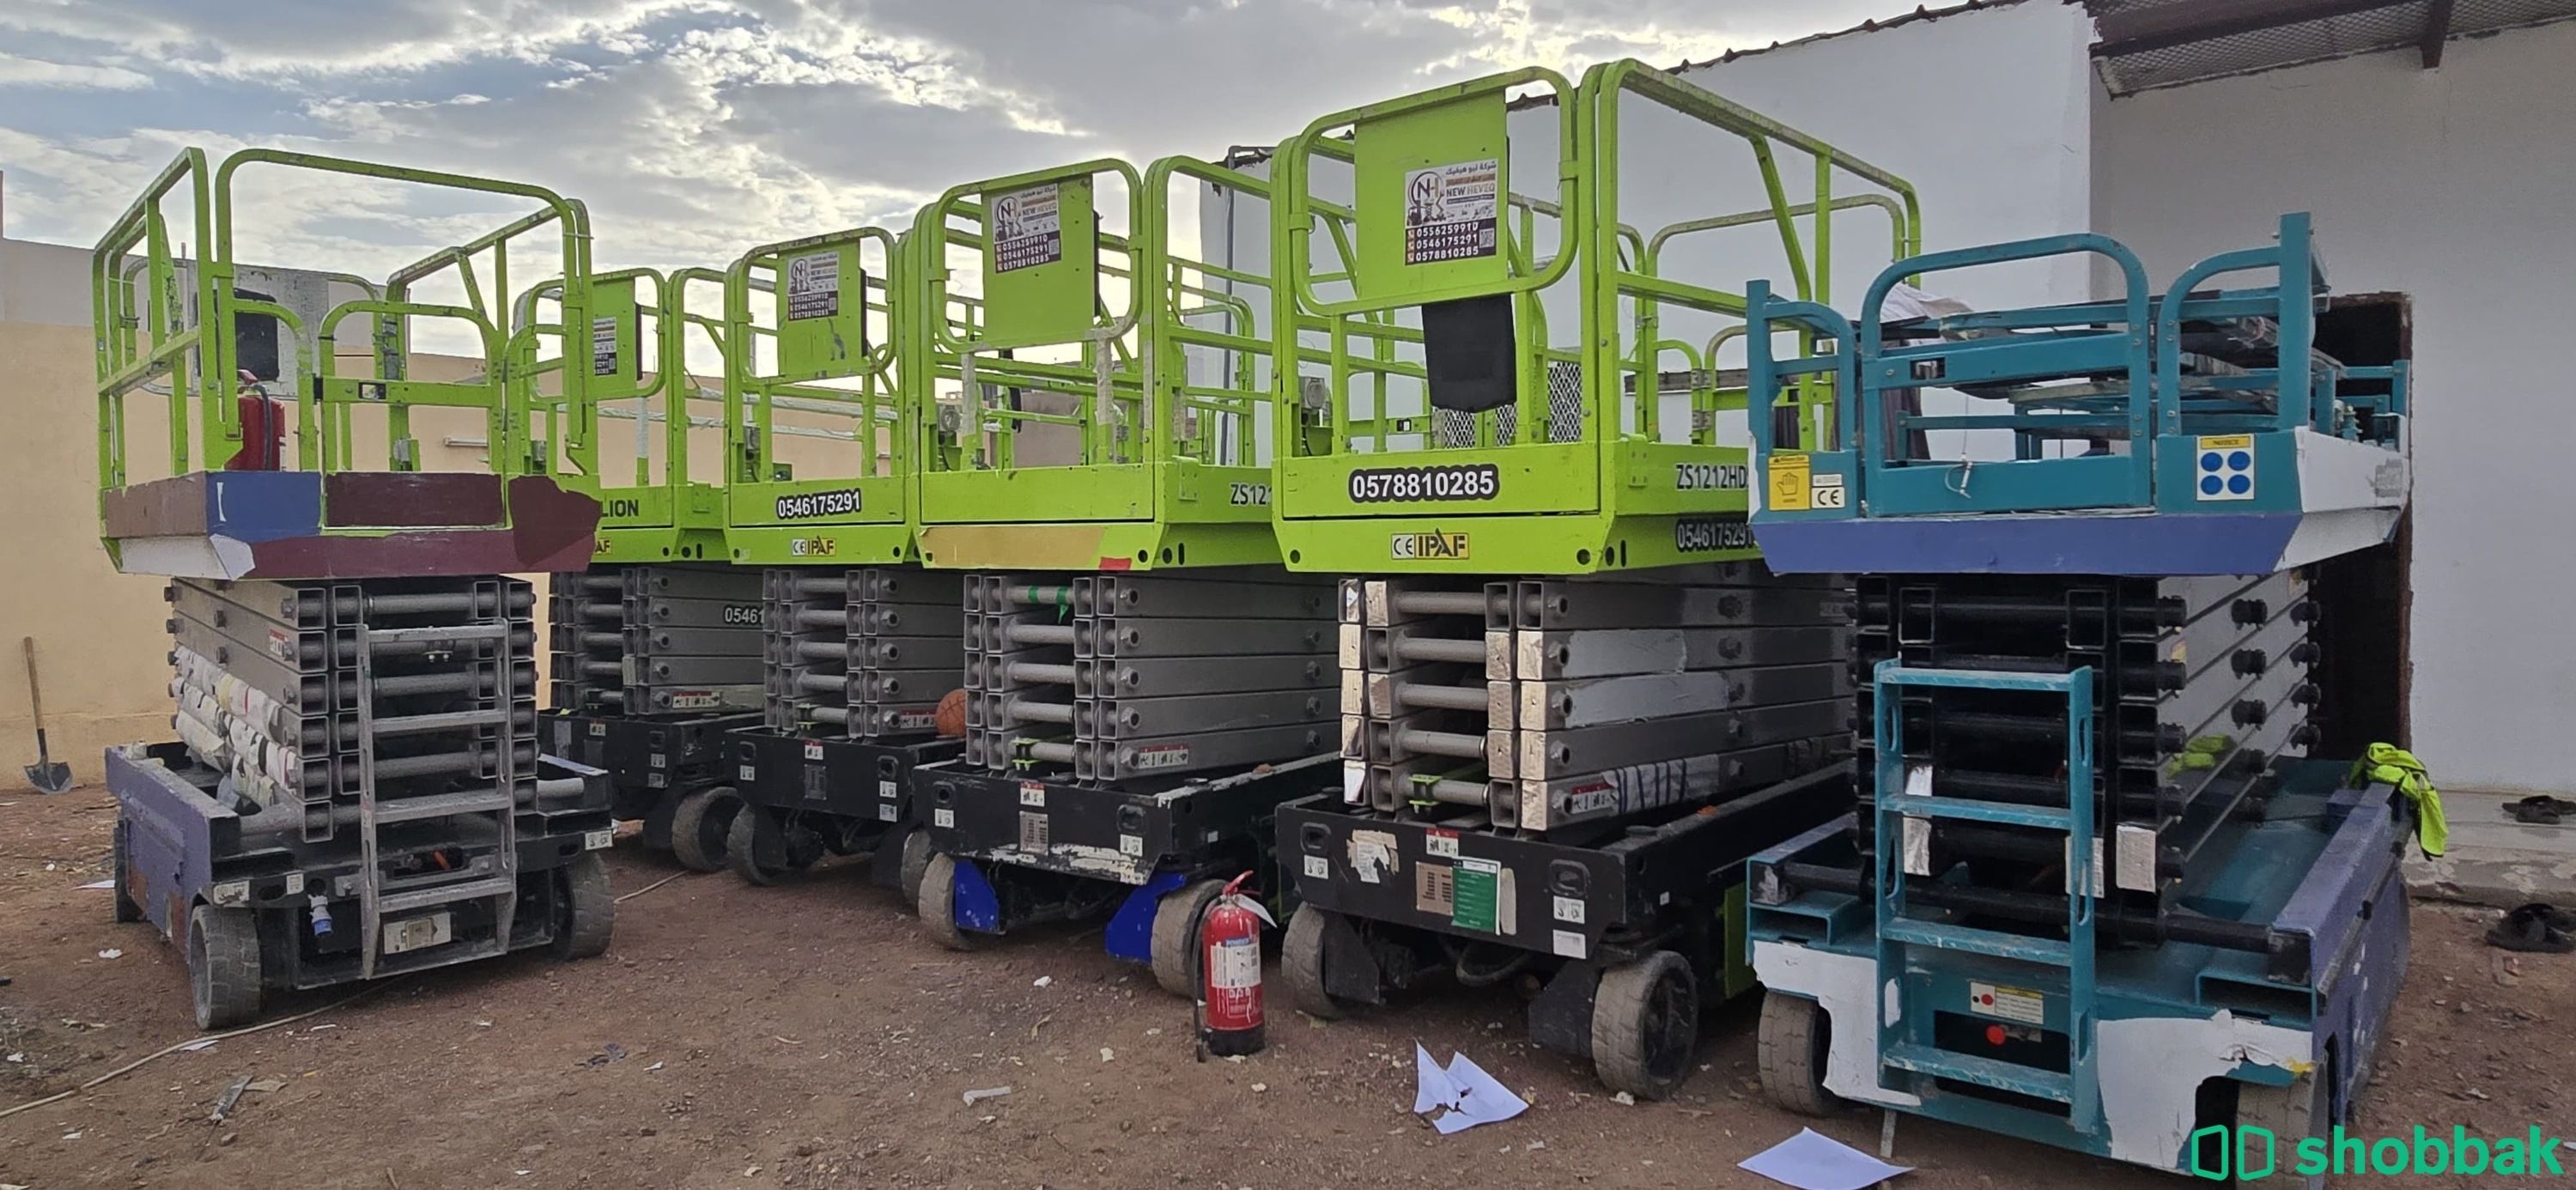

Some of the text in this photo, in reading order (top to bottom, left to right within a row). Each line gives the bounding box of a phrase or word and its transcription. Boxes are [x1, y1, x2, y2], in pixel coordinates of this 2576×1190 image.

[1446, 186, 1466, 197] NEW
[1416, 222, 1479, 237] 0556259910
[1416, 234, 1478, 249] 0546175291
[1003, 244, 1048, 260] 0546175291
[1415, 246, 1479, 261] 0578810285
[1003, 253, 1049, 270] 0578810285
[1352, 470, 1495, 498] 0578810285
[1675, 464, 1749, 490] ZS1212HD
[1230, 483, 1273, 506] ZS12
[1817, 489, 1840, 507] CE
[778, 490, 860, 518] 0546175291
[1394, 527, 1466, 557] CE IPAF
[1677, 521, 1753, 549] 0546175291
[807, 535, 835, 555] IPAF
[725, 606, 765, 624] 05461
